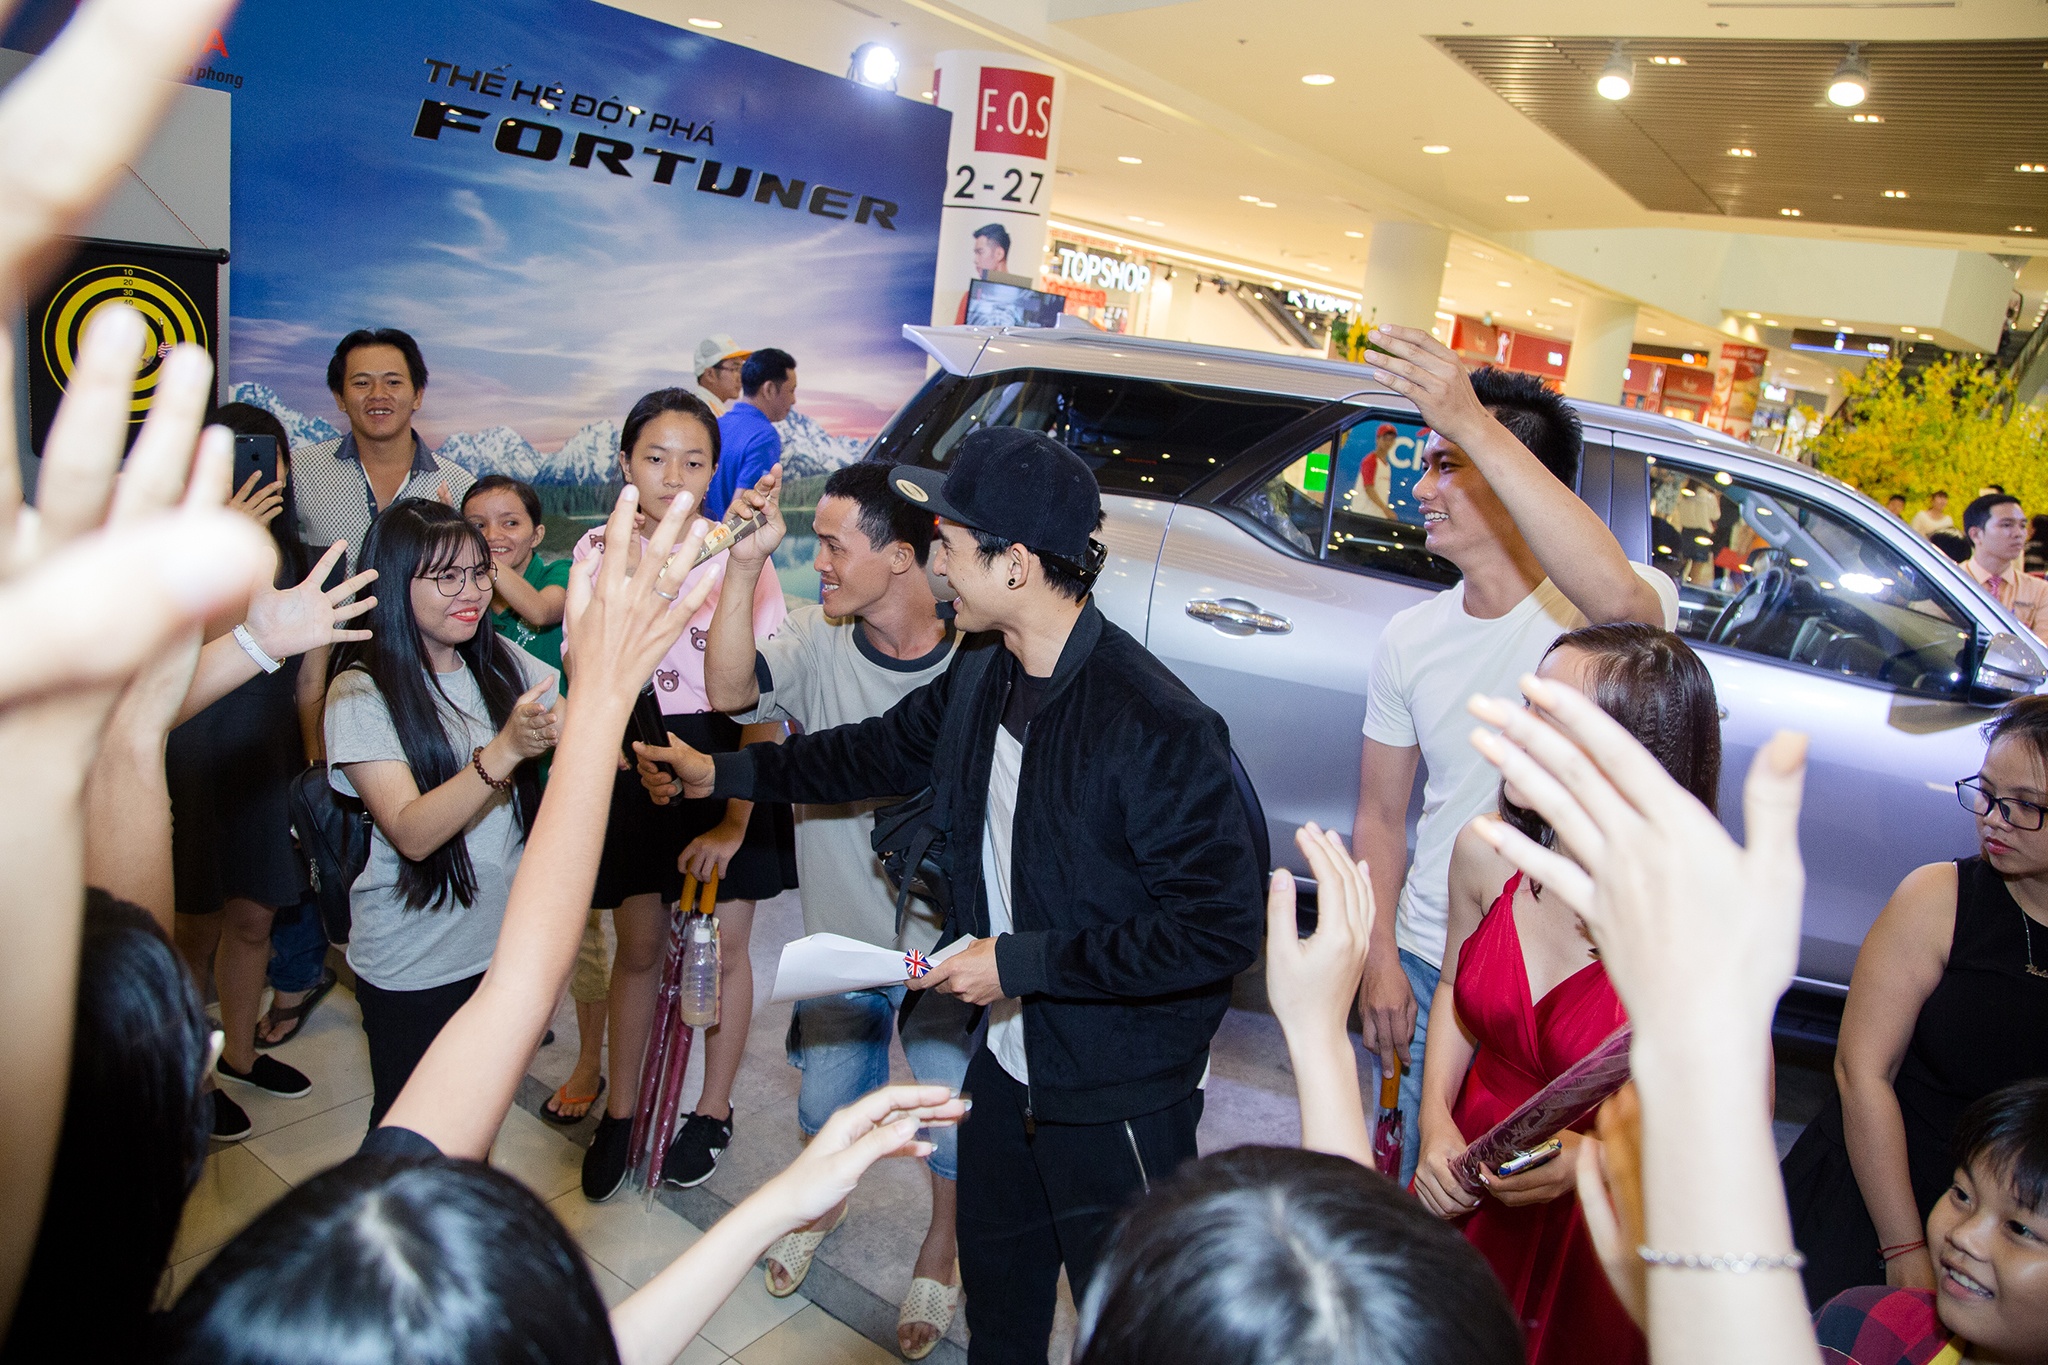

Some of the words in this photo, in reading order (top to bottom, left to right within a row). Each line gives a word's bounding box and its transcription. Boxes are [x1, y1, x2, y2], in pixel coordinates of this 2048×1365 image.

[196, 66, 244, 89] phong
[424, 57, 513, 97] THẾ
[510, 80, 567, 117] HỆ
[569, 95, 646, 130] ĐỘT
[648, 119, 716, 146] PHÁ
[981, 88, 1050, 138] F.O.S
[412, 98, 900, 231] FORTUNER
[123, 268, 134, 276] 10
[123, 289, 134, 297] 30
[1058, 247, 1151, 294] TOPSHOP
